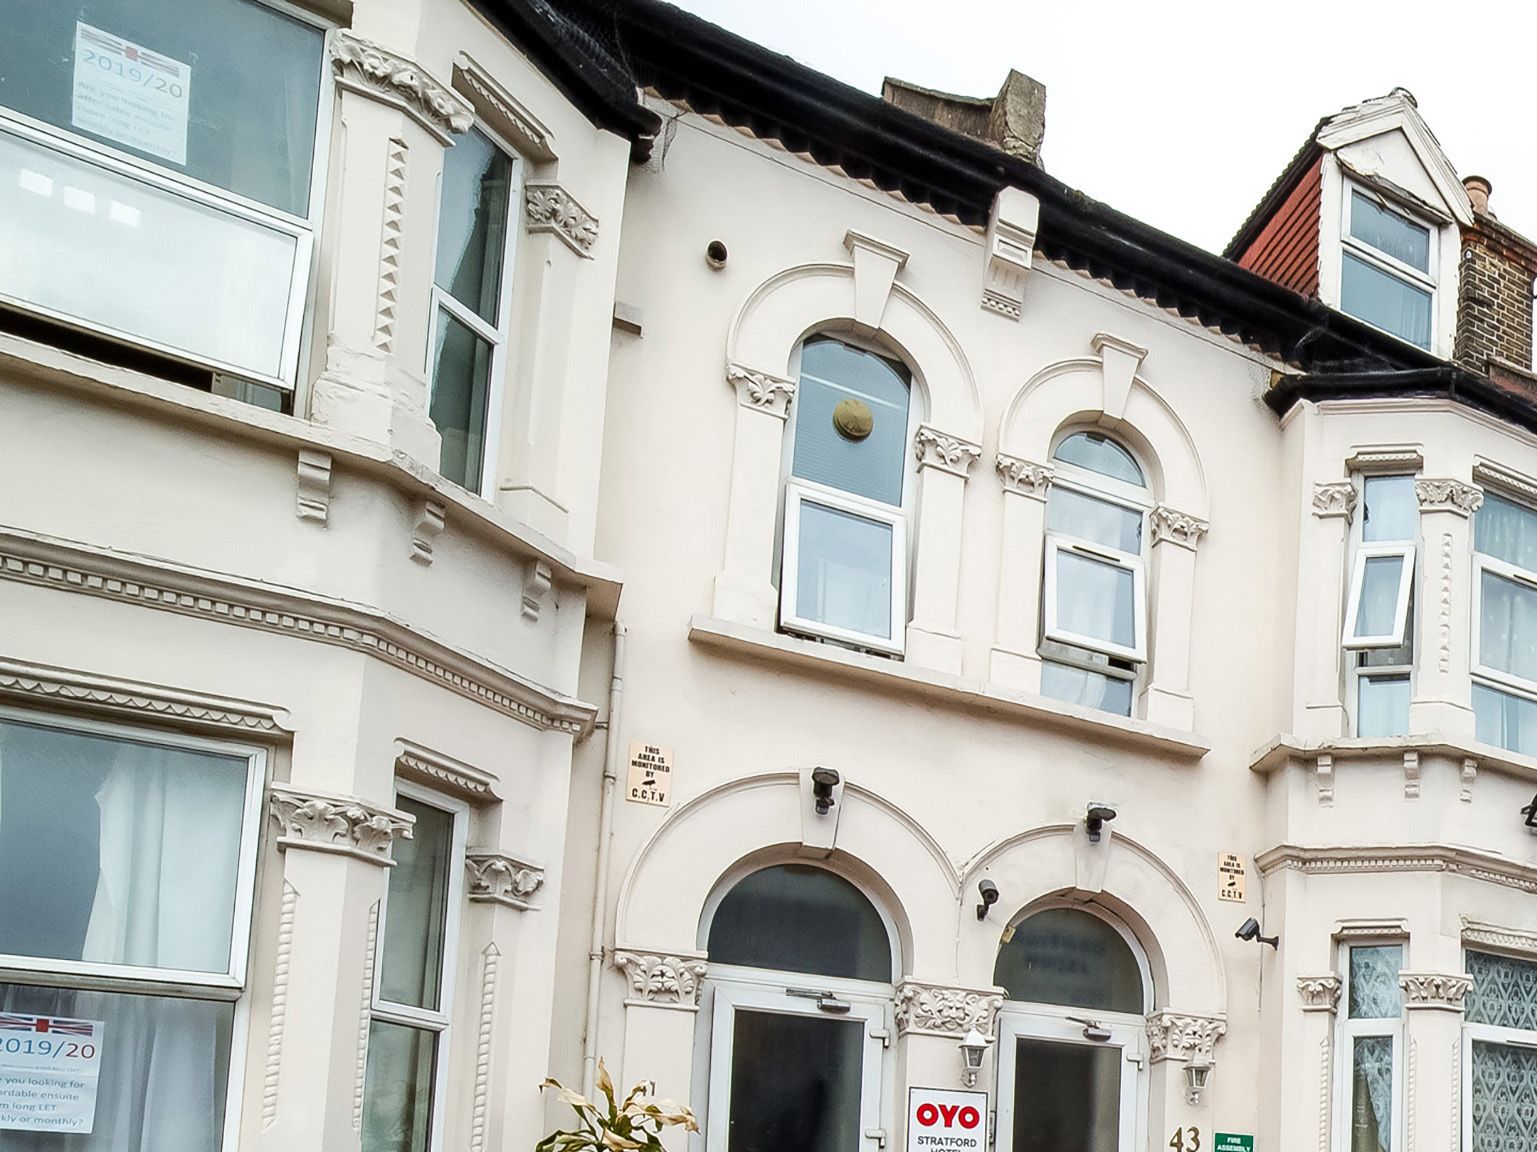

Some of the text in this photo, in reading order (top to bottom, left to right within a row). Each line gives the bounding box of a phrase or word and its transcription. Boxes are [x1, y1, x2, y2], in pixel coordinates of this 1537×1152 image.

[82, 48, 183, 99] 2019/20
[645, 746, 660, 755] THIS
[638, 753, 655, 762] AREA
[632, 760, 669, 772] MONITORED
[646, 770, 654, 778] BY
[632, 788, 664, 802] C.C.T.V
[0, 1038, 95, 1058] 019/20
[28, 1078, 67, 1088] looking
[70, 1080, 85, 1088] for
[917, 1103, 979, 1129] OYO
[917, 1136, 977, 1147] STRATFORD
[1169, 1127, 1200, 1152] 43
